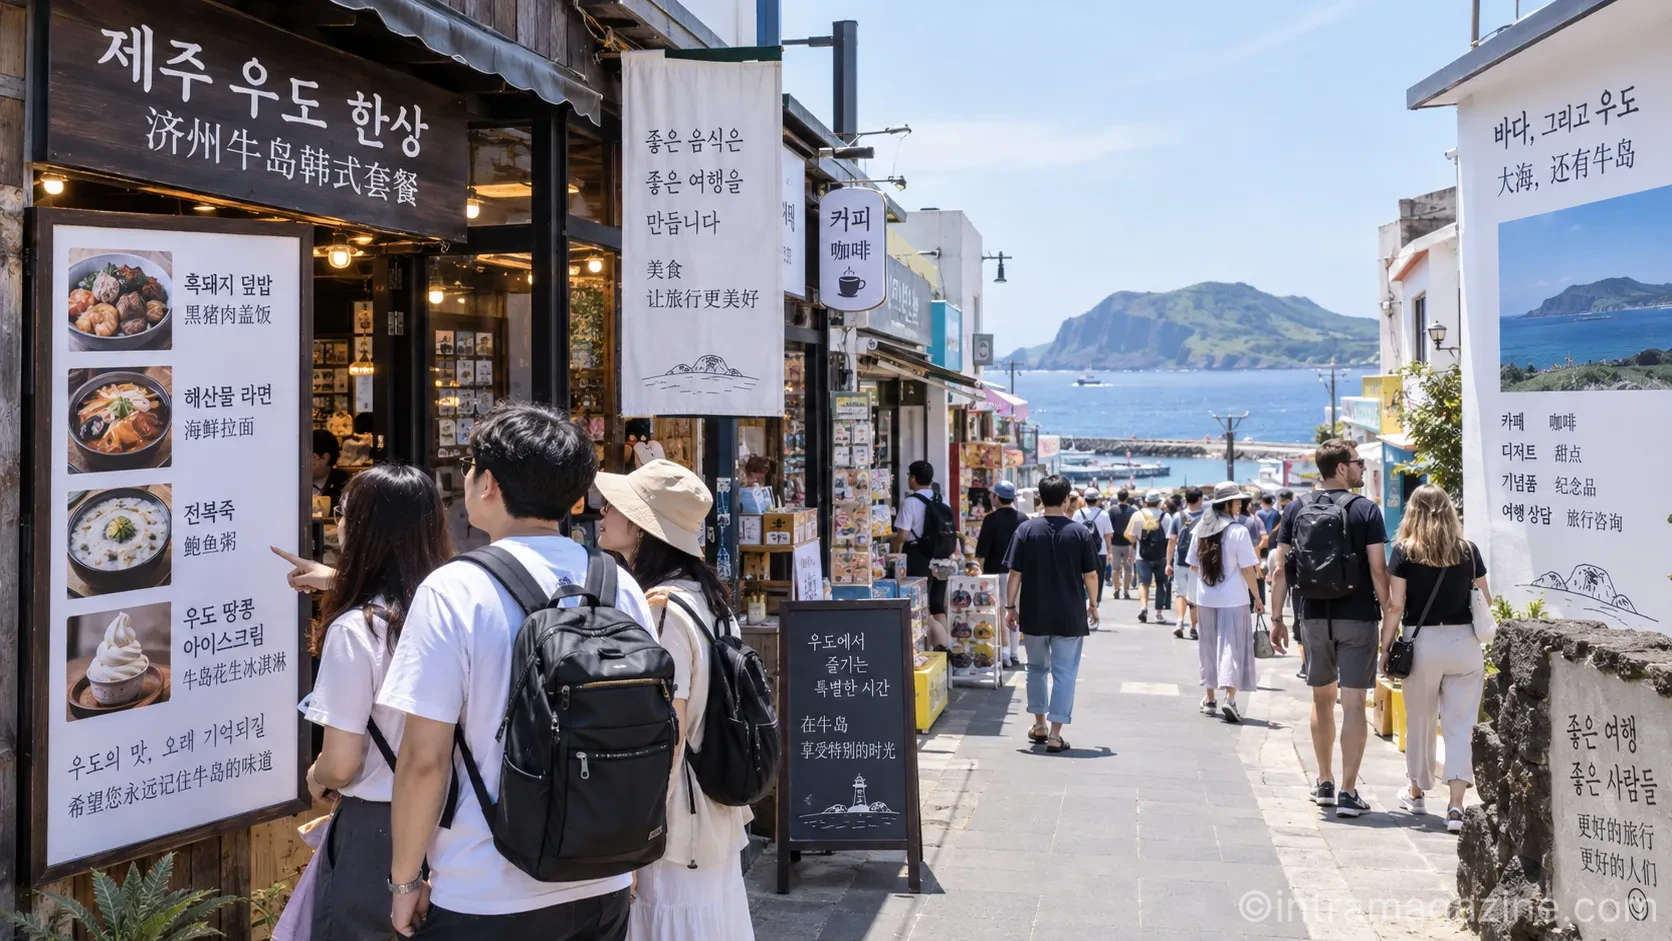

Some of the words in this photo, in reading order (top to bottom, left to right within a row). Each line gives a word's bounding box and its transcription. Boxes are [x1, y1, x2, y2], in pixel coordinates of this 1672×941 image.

[96, 23, 214, 103] 제주
[228, 56, 328, 130] 우도
[346, 90, 430, 158] 한상
[1494, 110, 1535, 150] 바다,
[1541, 103, 1590, 136] 그리고
[1595, 85, 1640, 126] 우도
[645, 129, 682, 154] 좋은
[688, 127, 744, 153] 음식은
[144, 105, 419, 208] 济州牛岛韩式套餐
[645, 170, 682, 195] 좋은
[689, 169, 744, 194] 여행을
[646, 210, 721, 235] 만듭니다
[830, 206, 871, 232] 커피
[830, 239, 871, 261] 咖啡
[646, 259, 683, 280] 美食
[184, 273, 234, 296] 흑돼지
[241, 273, 273, 296] 덮밥
[646, 289, 759, 309] 让旅行更美好
[184, 304, 271, 325] 黑猪肉盖饭
[184, 385, 235, 408] 해산물
[241, 383, 272, 407] 라면
[184, 416, 254, 440] 海鲜拉面
[1501, 412, 1524, 431] 카페
[1549, 413, 1576, 432] 咖啡
[1502, 442, 1537, 461] 디저트
[1555, 444, 1582, 463] 甜点
[1502, 472, 1538, 493] 기념품
[1555, 476, 1596, 497] 纪念品
[184, 499, 235, 525] 전복죽
[1502, 502, 1524, 523] 여행
[1528, 505, 1552, 525] 상담
[1567, 509, 1623, 533] 旅行咨询
[184, 531, 236, 557] 鲍鱼粥
[183, 607, 217, 630] 우도
[223, 598, 255, 624] 땅콩
[183, 623, 264, 658] 아이스크림
[808, 632, 865, 651] 우도에서
[183, 651, 287, 690] 牛岛花生冰淇淋
[825, 656, 869, 674] 즐기는
[814, 679, 858, 698] 특별한
[861, 679, 890, 697] 시간
[800, 715, 848, 734] 在牛岛
[1567, 714, 1598, 750] 좋은
[1605, 714, 1637, 754] 여행
[68, 746, 121, 781] 우도의
[130, 740, 152, 767] 맛,
[162, 729, 195, 757] 오래
[204, 713, 265, 748] 기억되길
[68, 750, 273, 819] 希望您永远记住牛岛的味道
[1570, 762, 1601, 796] 좋은
[1606, 764, 1658, 806] 사람들
[1577, 813, 1654, 851] 更好的旅行
[1580, 847, 1657, 888] 更好的人们
